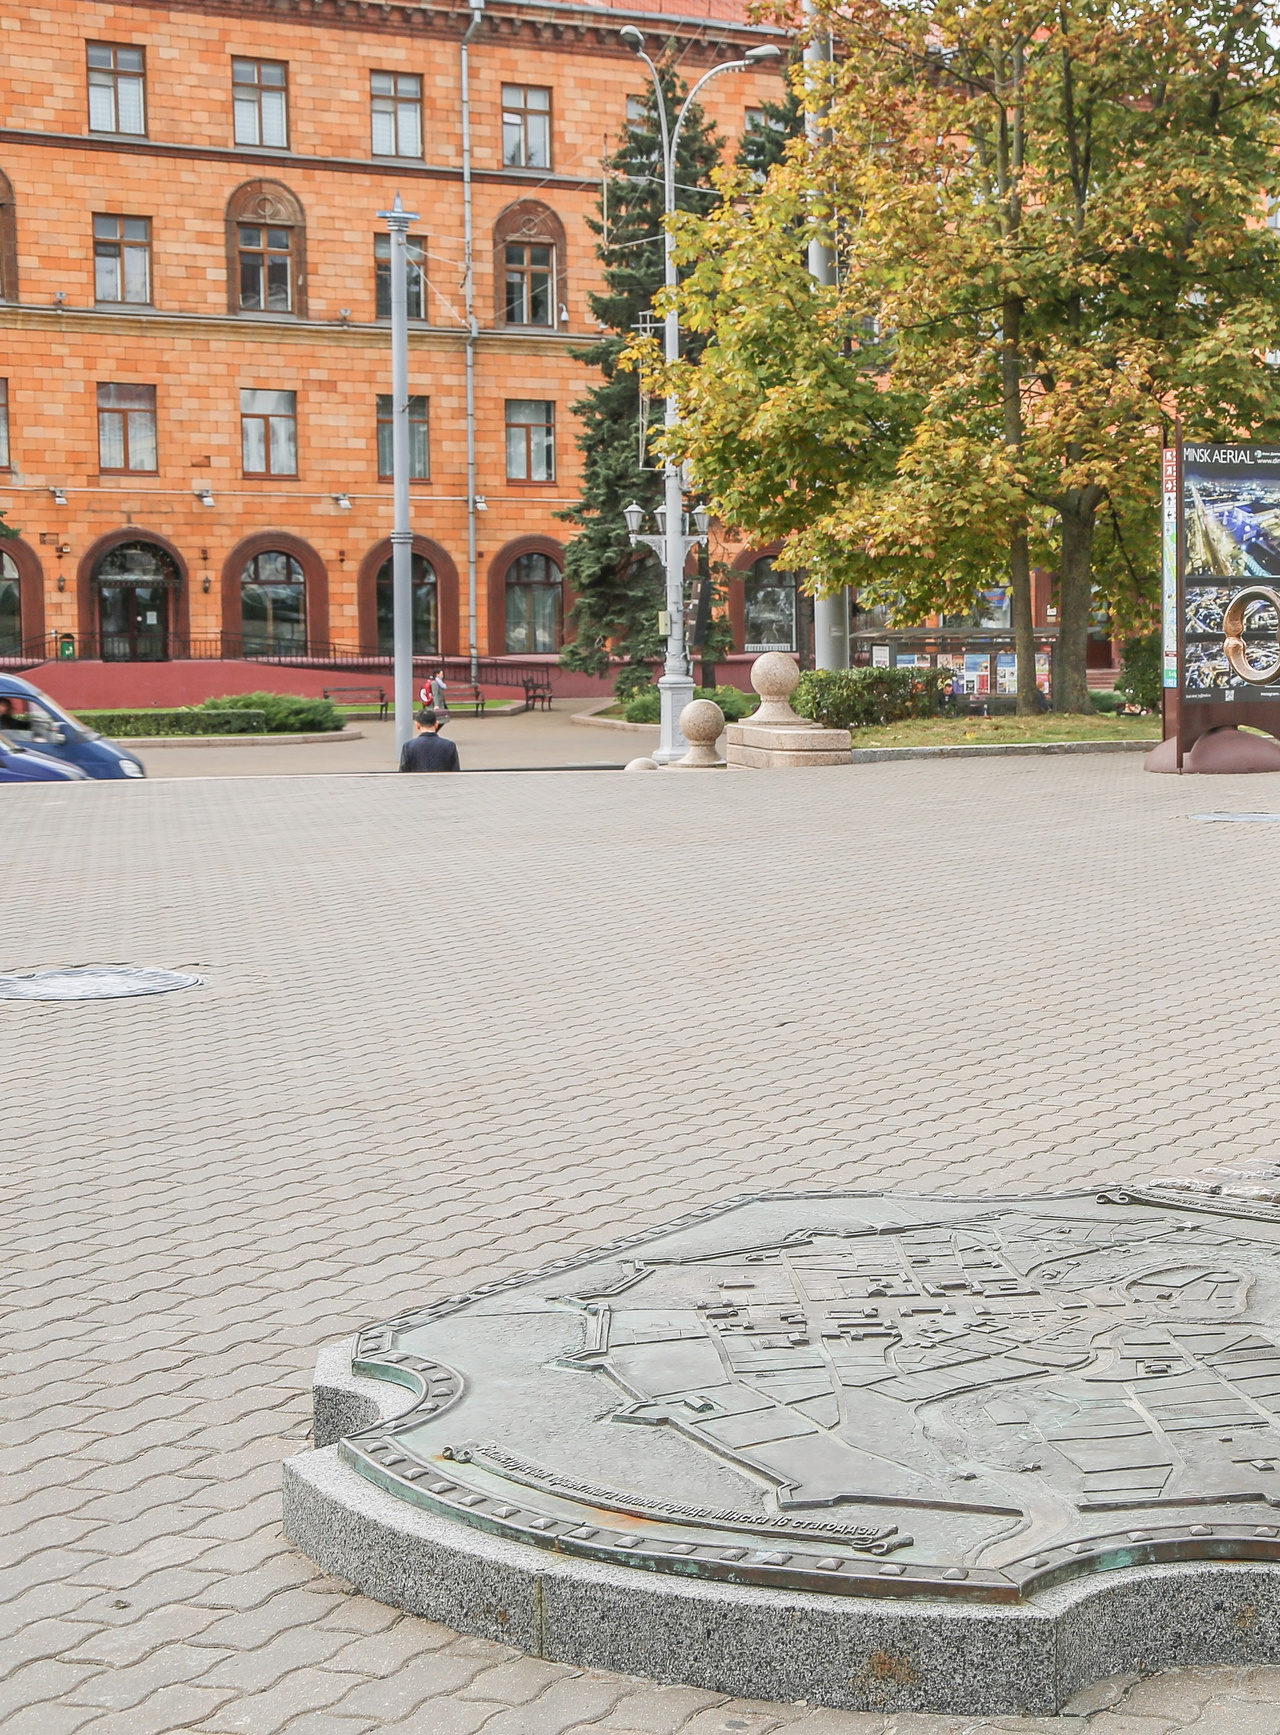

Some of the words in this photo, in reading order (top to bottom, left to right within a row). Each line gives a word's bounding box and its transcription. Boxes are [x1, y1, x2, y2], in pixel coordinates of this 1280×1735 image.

[1183, 447, 1211, 463] MINSK
[1212, 449, 1255, 464] AERIAL
[711, 1507, 769, 1526] Мінска
[771, 1515, 791, 1528] 16
[792, 1518, 880, 1537] стагоддзя
